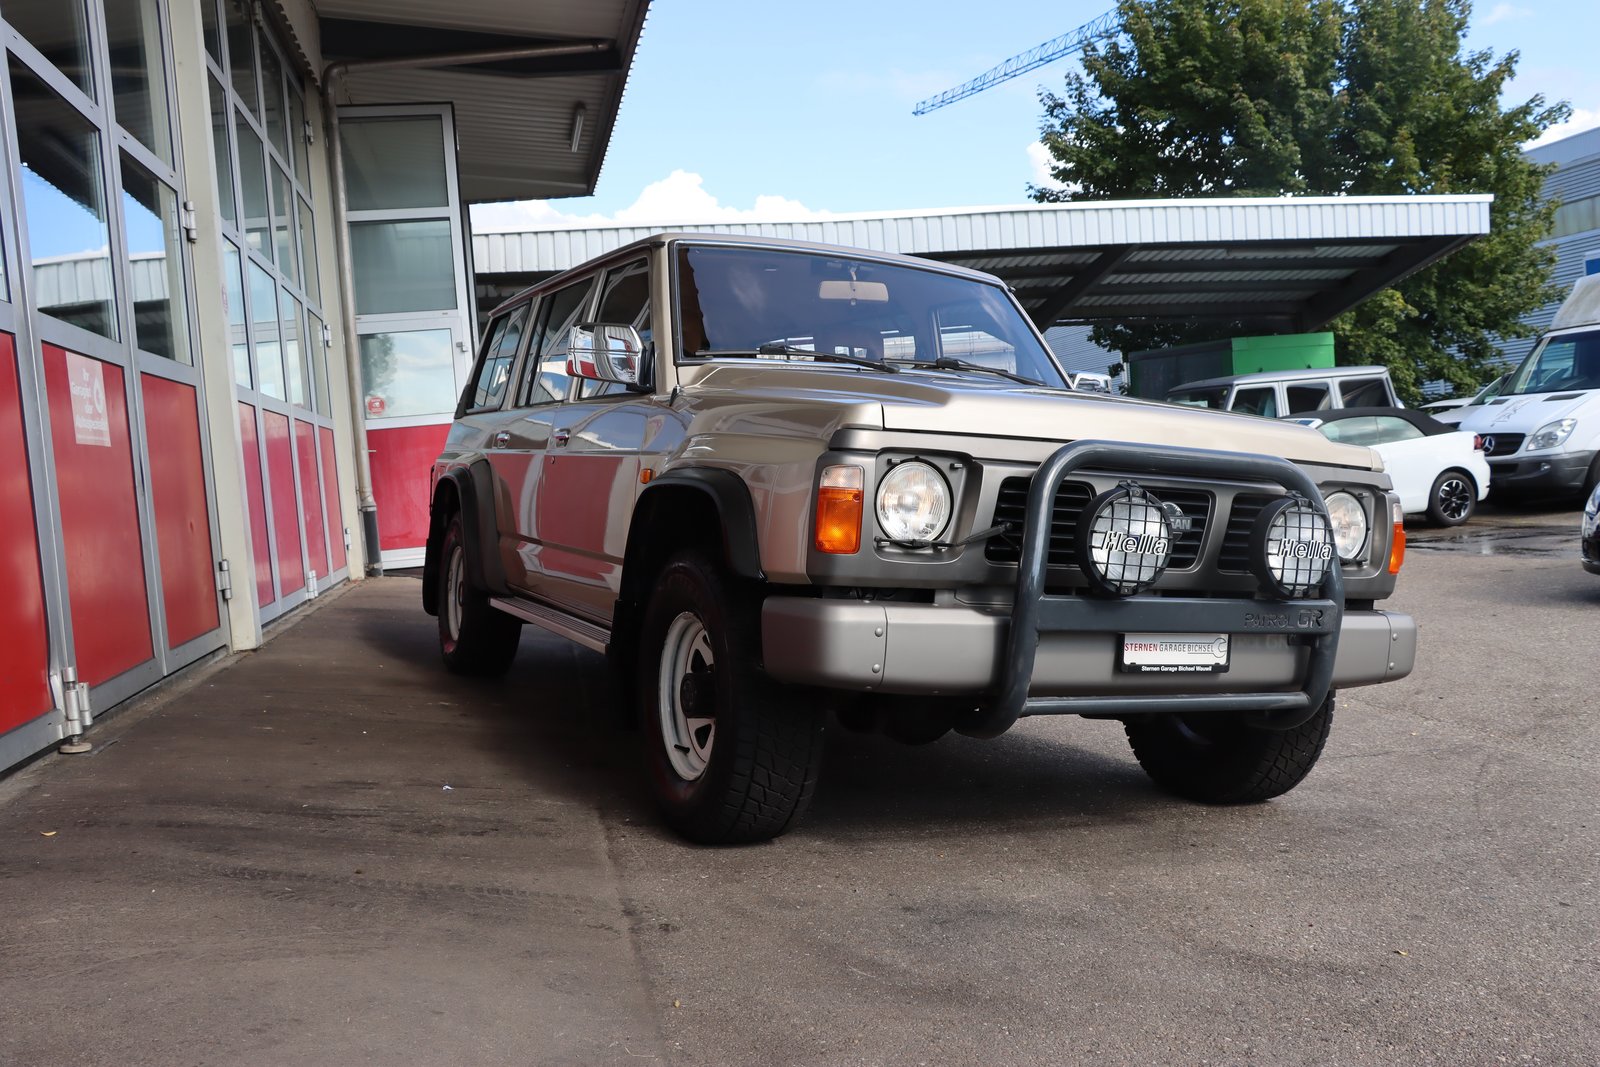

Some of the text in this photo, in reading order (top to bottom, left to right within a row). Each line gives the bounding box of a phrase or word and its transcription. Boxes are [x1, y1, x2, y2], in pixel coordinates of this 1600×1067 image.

[1101, 530, 1168, 556] Hella
[1278, 538, 1332, 560] Hella
[1244, 609, 1324, 629] PATROL GR
[1124, 642, 1214, 653] STERNEN GARAGE BICHSEL
[1160, 665, 1178, 673] Garage
